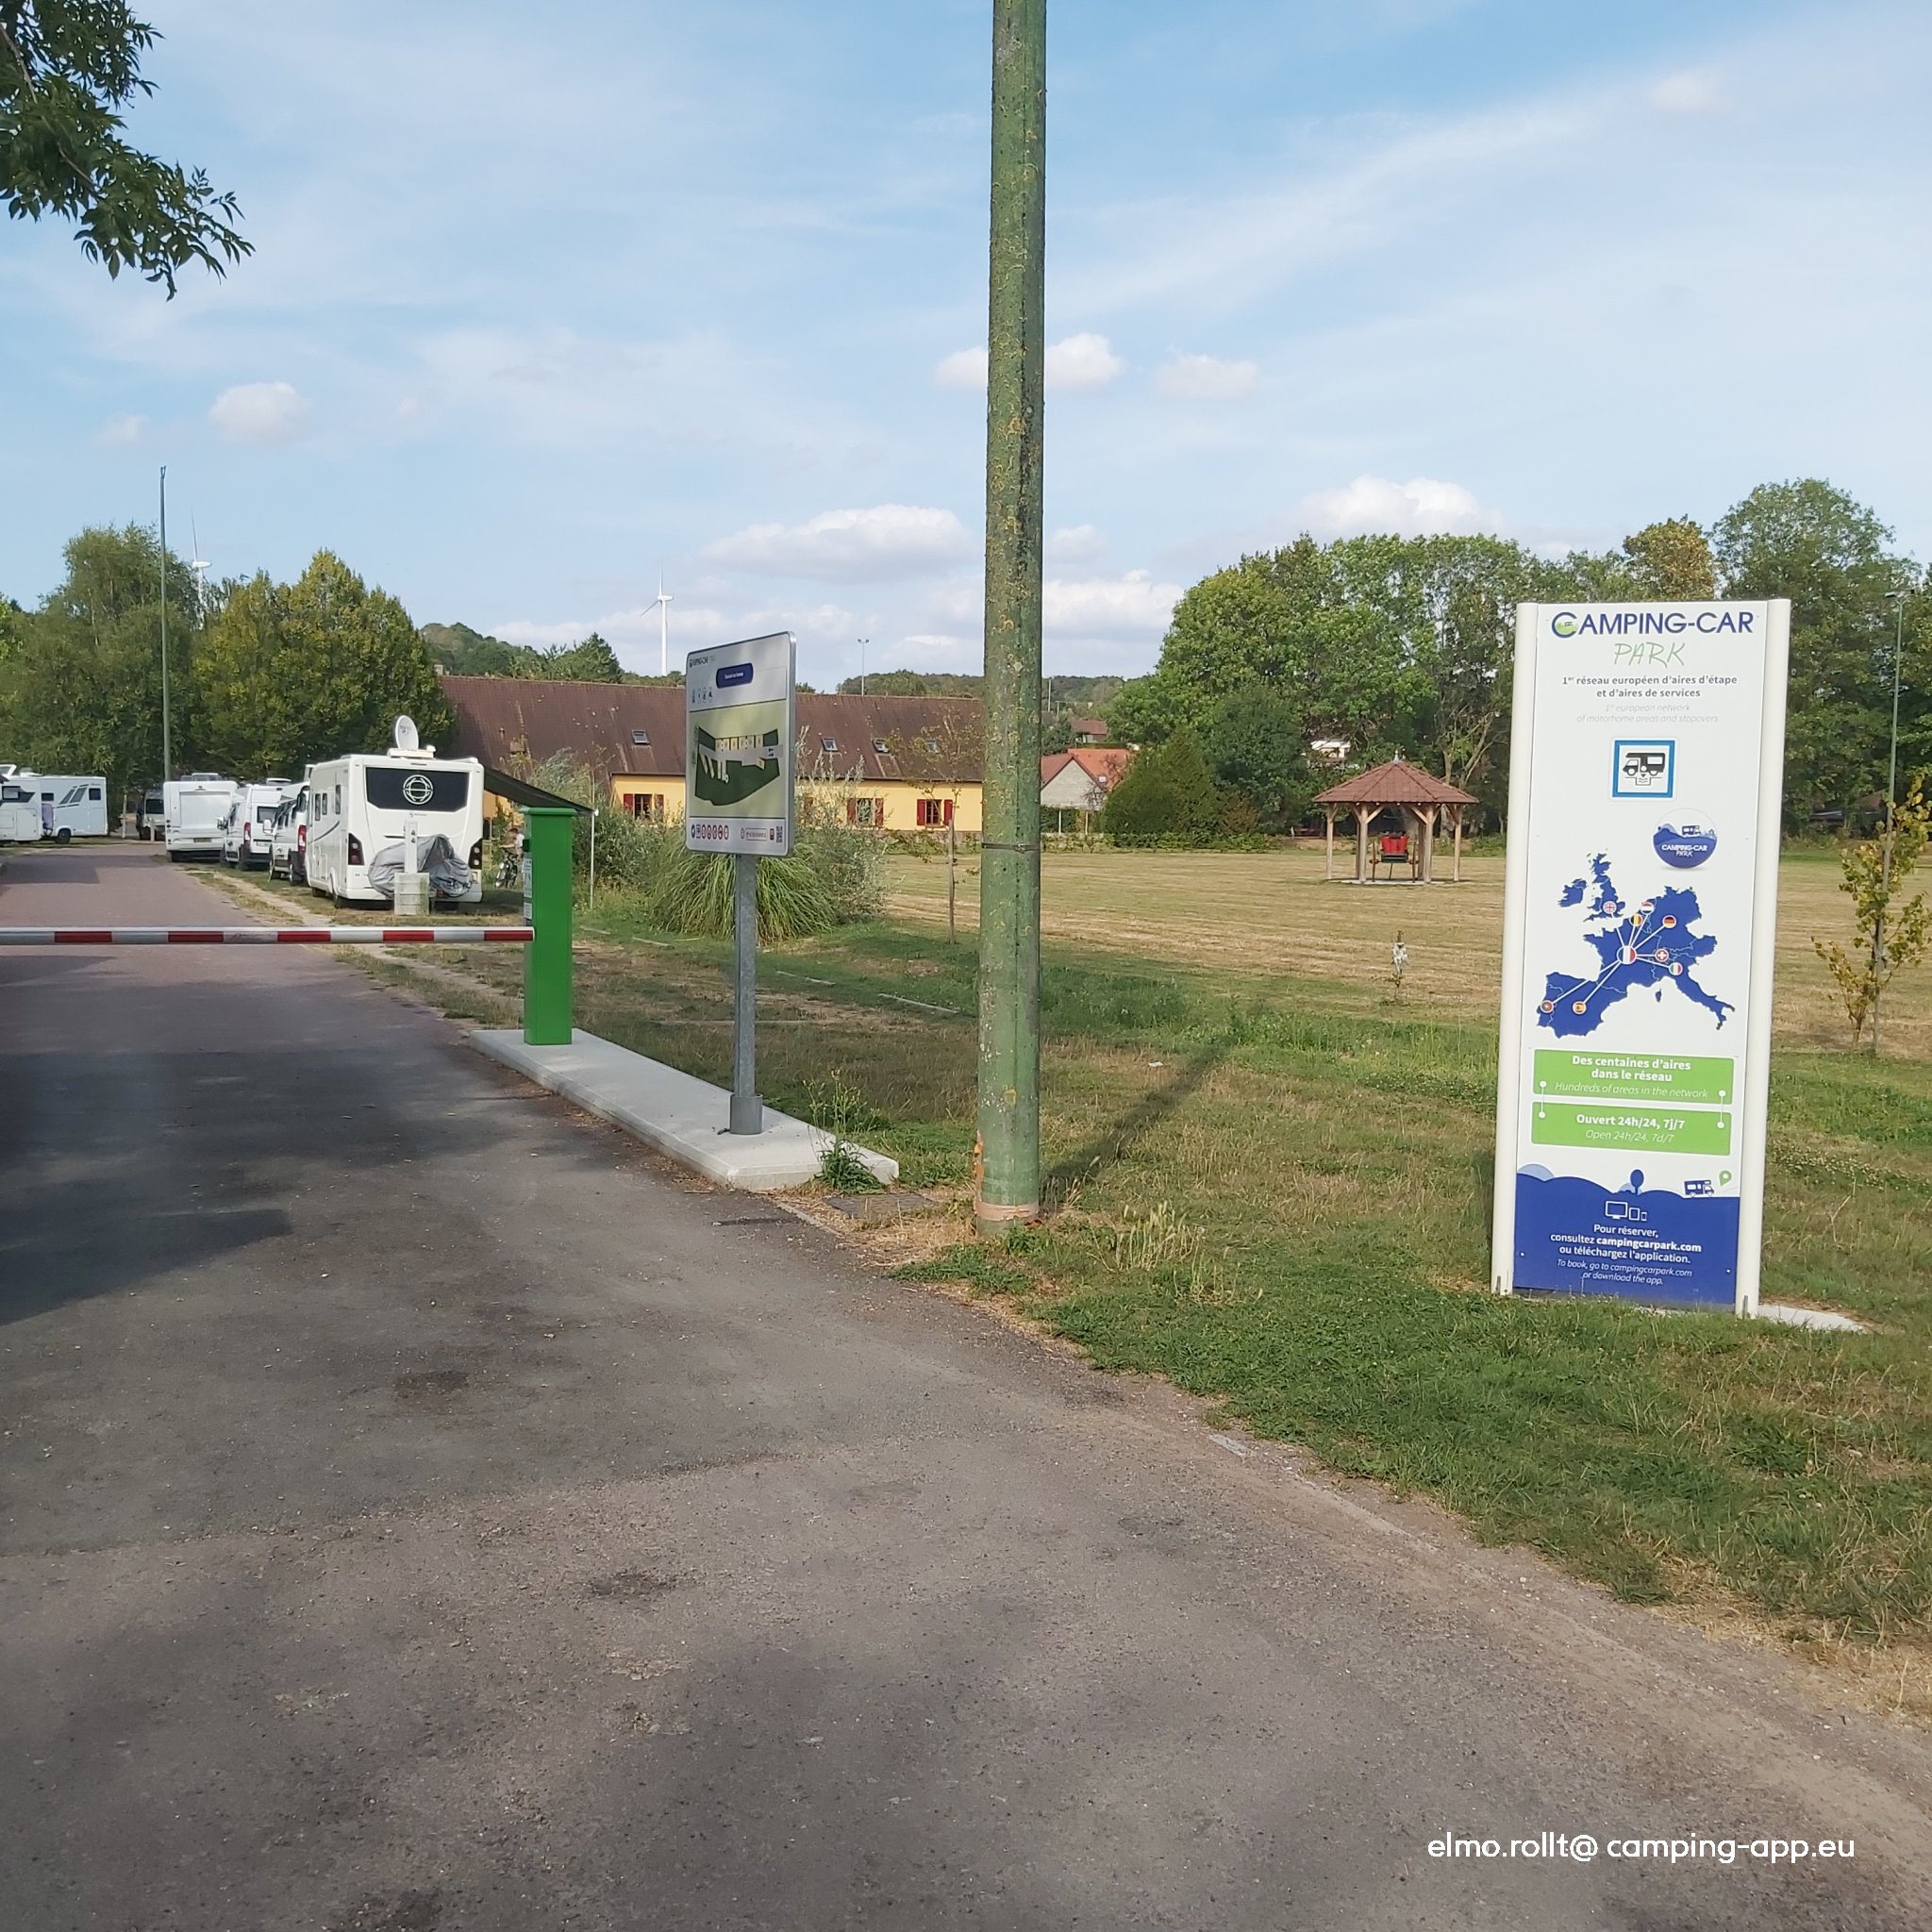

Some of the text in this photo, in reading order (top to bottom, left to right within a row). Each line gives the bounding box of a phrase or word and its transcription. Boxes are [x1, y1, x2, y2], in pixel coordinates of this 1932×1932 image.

[1551, 611, 1754, 639] CAMPING-CAR
[1613, 641, 1686, 668] PARK
[1576, 676, 1609, 685] réseau
[1611, 675, 1658, 686] européen
[1662, 675, 1696, 685] d'aires
[1596, 689, 1701, 698] et d'aires de services
[1572, 1055, 1690, 1070] Des centaines d'aires
[1591, 1069, 1672, 1081] dans le réseau
[1555, 1081, 1600, 1092] Hundreds
[1602, 1083, 1613, 1094] of
[1652, 1087, 1668, 1096] the
[1670, 1088, 1707, 1098] network
[1576, 1114, 1685, 1130] Ouvert 24h/24, 7j/7
[1585, 1130, 1674, 1143] Open 24h/24, 7d/7
[1594, 1224, 1658, 1238] Pour réserver,
[1551, 1234, 1702, 1253] consultez campingcarpark.com
[1574, 1246, 1627, 1259] téléchargez
[1567, 1258, 1589, 1270] book,
[1609, 1264, 1692, 1276] campingcarpark.com
[1592, 1272, 1632, 1282] download
[1633, 1274, 1645, 1283] the
